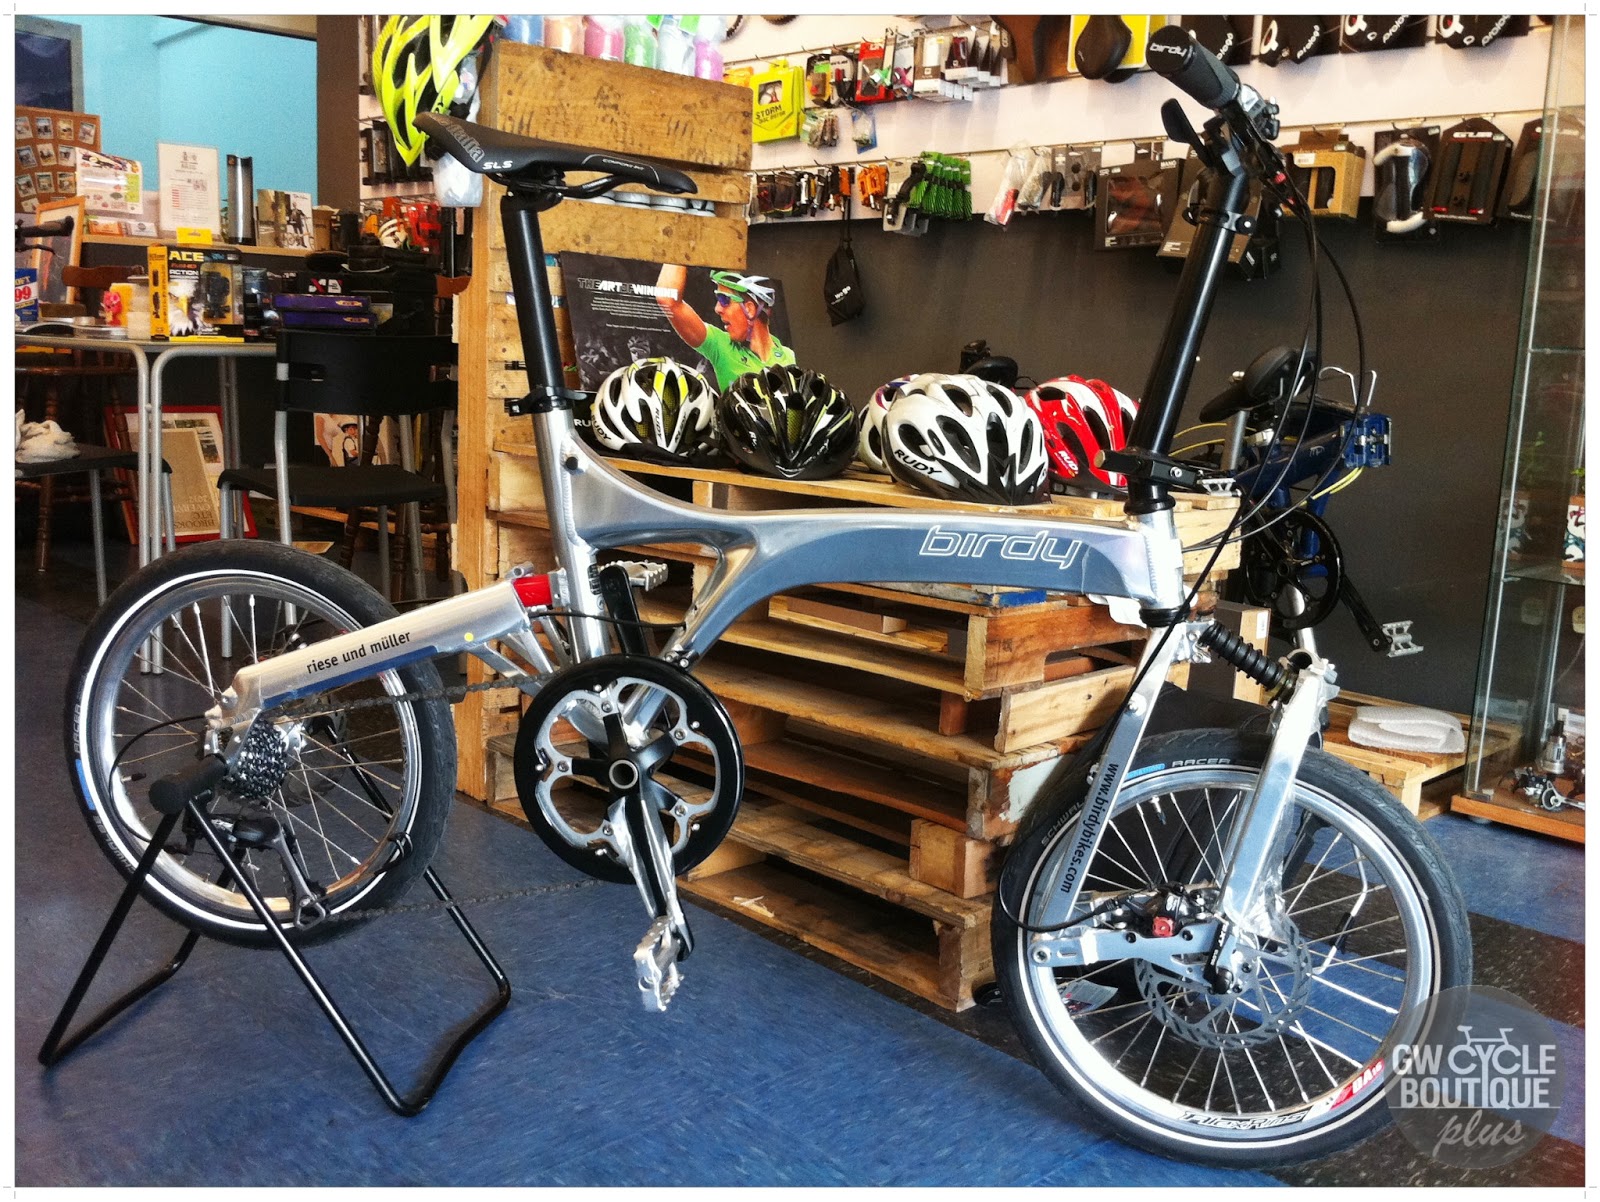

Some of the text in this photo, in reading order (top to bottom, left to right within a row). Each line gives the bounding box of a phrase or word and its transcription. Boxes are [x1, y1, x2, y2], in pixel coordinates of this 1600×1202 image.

[1149, 42, 1187, 57] birdy
[1216, 32, 1234, 60] ologo
[1296, 24, 1320, 59] prologo
[755, 104, 783, 120] STORM
[482, 160, 514, 170] SLS
[168, 250, 204, 262] ACE
[591, 414, 612, 441] RUDY
[654, 407, 662, 440] RUDY
[894, 449, 942, 475] RUDY
[919, 525, 1083, 570] birdy
[306, 631, 411, 674] riese und müller
[73, 703, 82, 754] RACER
[1172, 758, 1231, 768] RACER
[1041, 801, 1085, 847] SCHWAL
[1060, 762, 1119, 894] www.birdybikes.com
